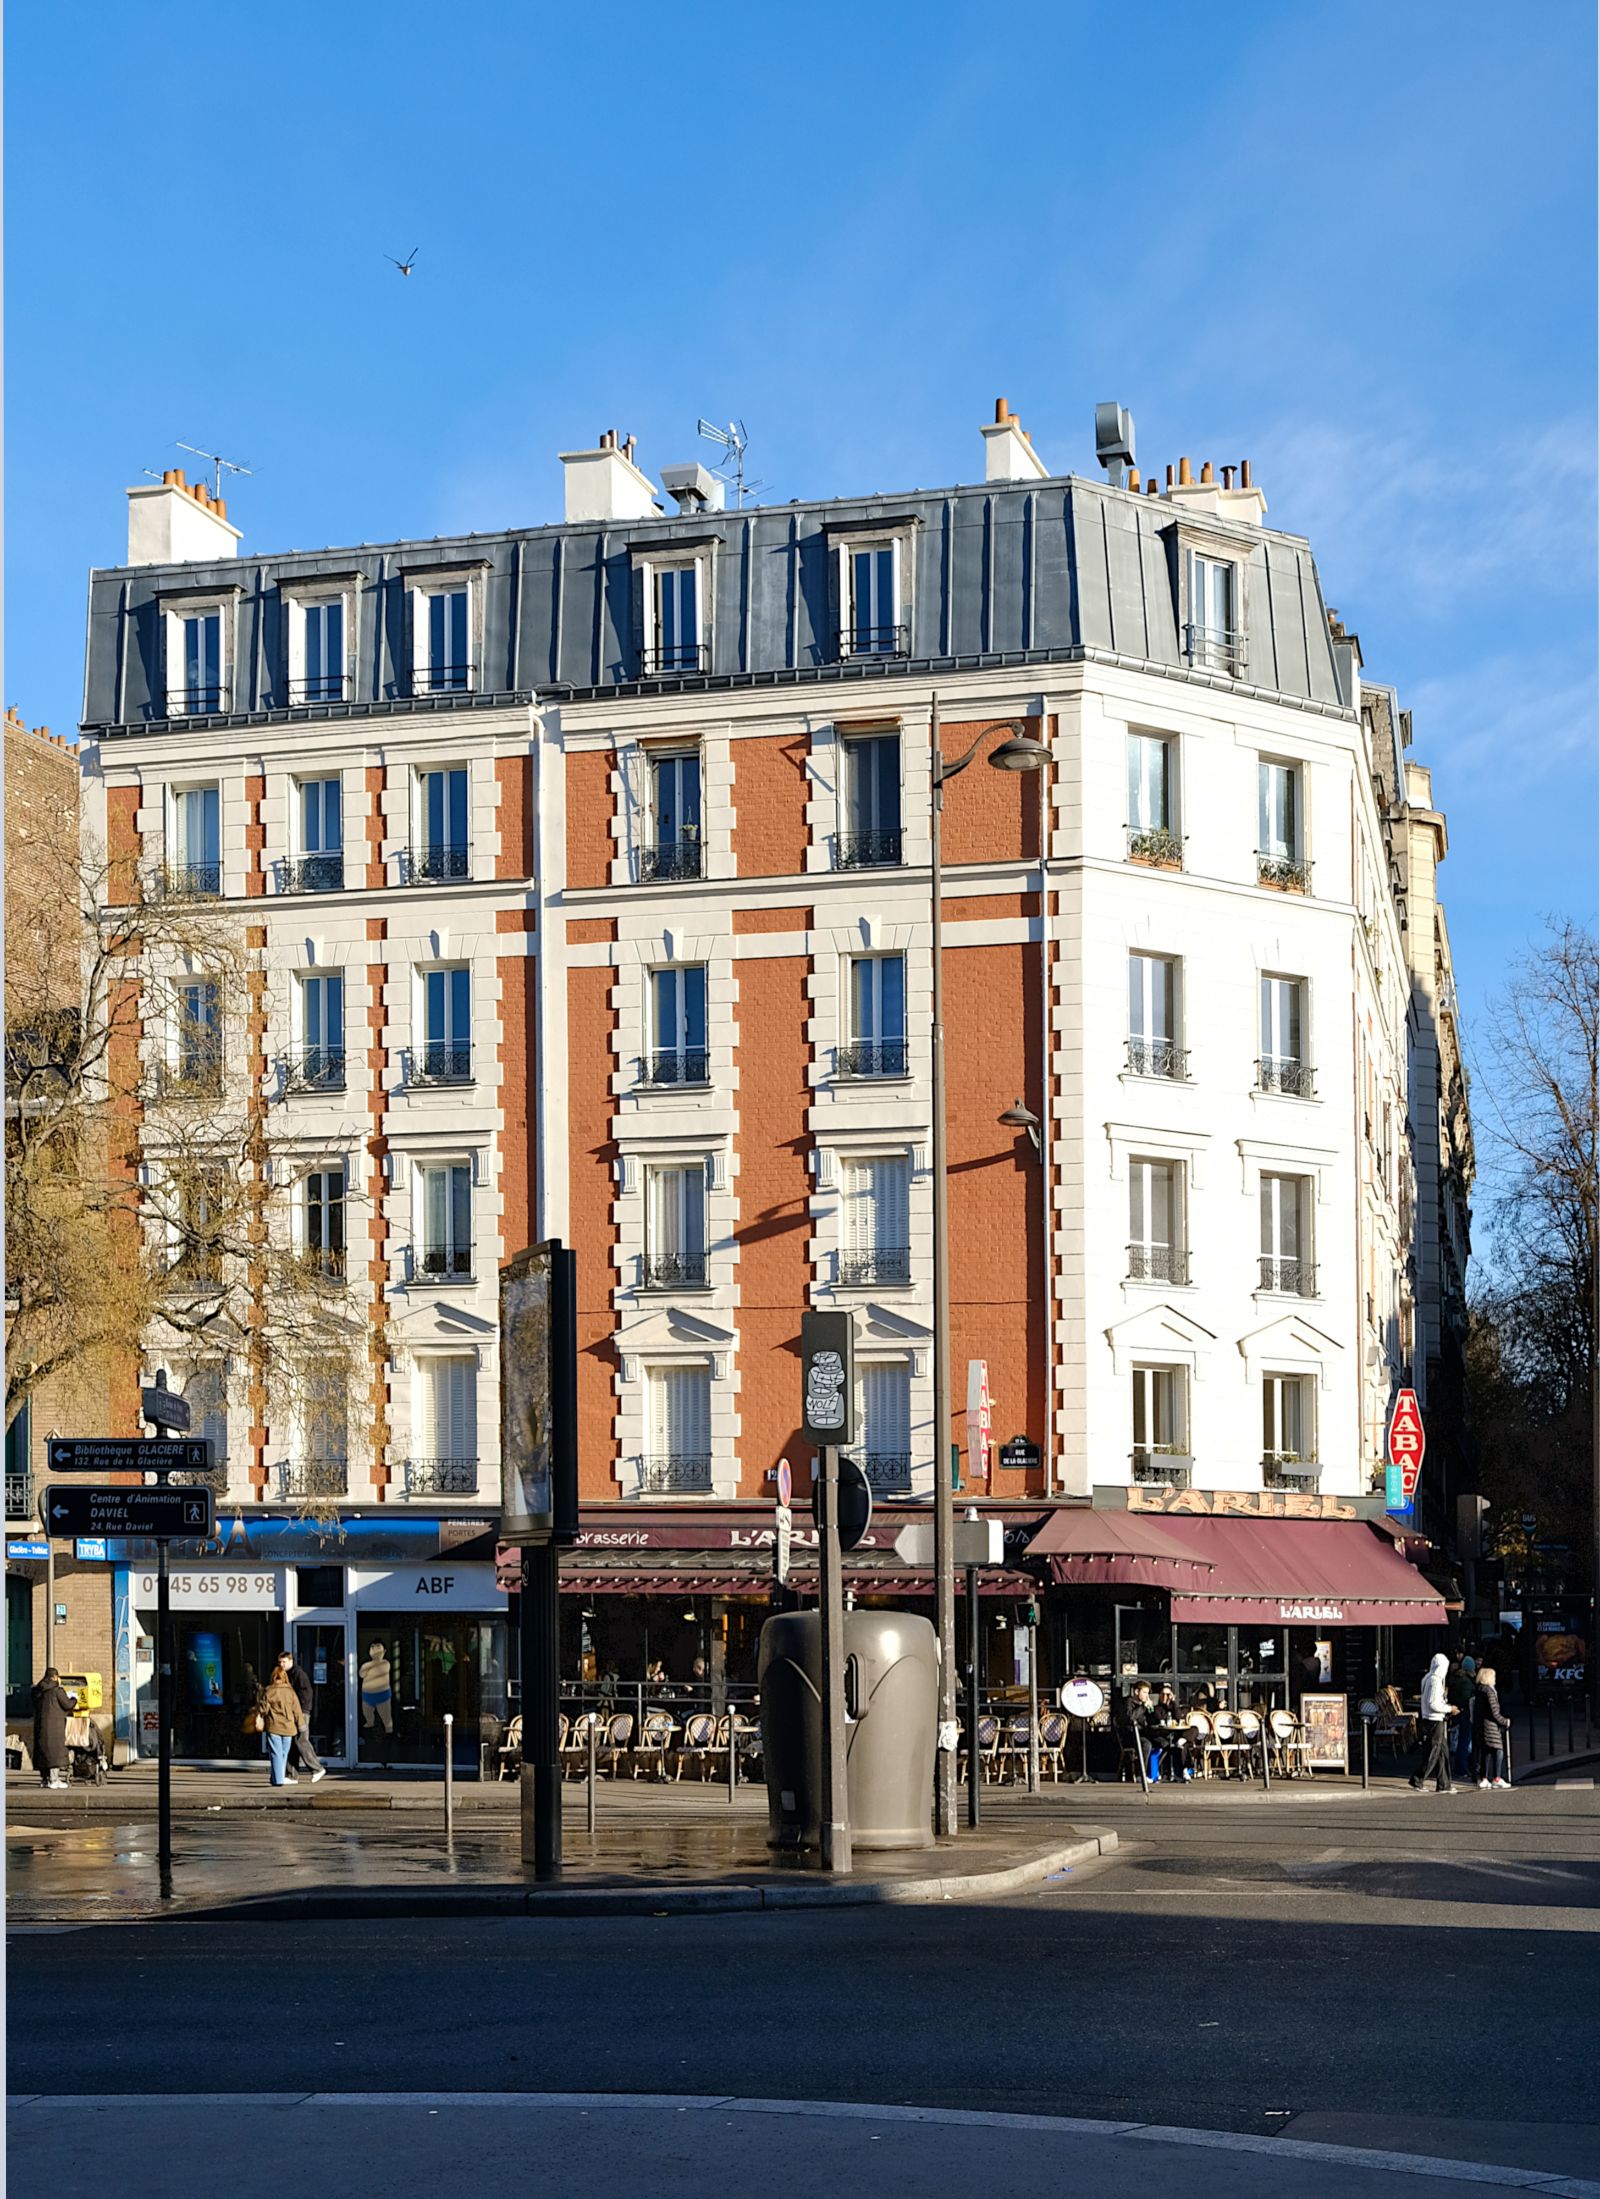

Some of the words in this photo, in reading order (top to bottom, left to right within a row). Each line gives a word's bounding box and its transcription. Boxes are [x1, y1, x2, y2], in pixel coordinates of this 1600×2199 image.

[980, 1366, 989, 1473] TABAC
[1393, 1396, 1419, 1489] TABAC
[74, 1444, 133, 1457] Bibliothèque
[138, 1444, 185, 1455] GLACIERE
[1014, 1448, 1026, 1456] RUE
[93, 1457, 109, 1466] Rue
[112, 1457, 123, 1466] de
[125, 1457, 134, 1466] la
[137, 1457, 173, 1466] Glacière
[89, 1493, 121, 1504] Centre
[126, 1493, 181, 1504] d'Animation
[1126, 1487, 1358, 1519] L'ARIEL
[90, 1507, 129, 1518] DAVIEL
[105, 1522, 122, 1531] Rue
[125, 1522, 154, 1531] Daviel
[448, 1529, 476, 1537] PORTES
[79, 1543, 105, 1556] TRYBA
[170, 1576, 192, 1593] 45
[198, 1576, 220, 1593] 65
[226, 1576, 248, 1593] 98
[254, 1576, 277, 1593] 98
[415, 1576, 455, 1594] ABF
[1280, 1605, 1344, 1620] L'ARIEL
[1554, 1668, 1585, 1680] KFC
